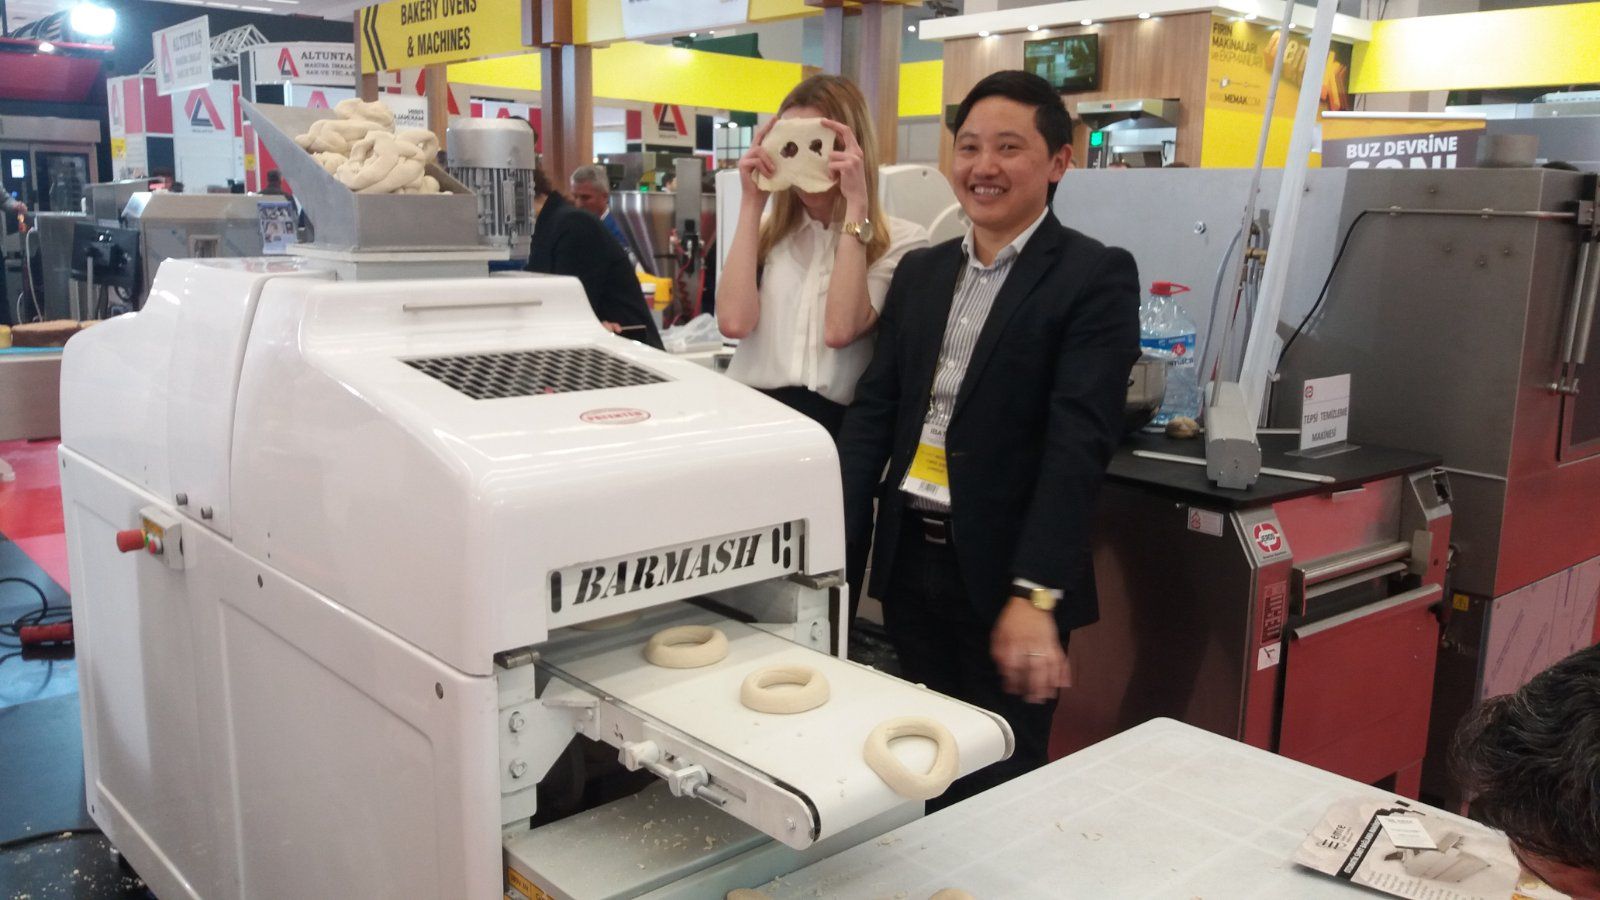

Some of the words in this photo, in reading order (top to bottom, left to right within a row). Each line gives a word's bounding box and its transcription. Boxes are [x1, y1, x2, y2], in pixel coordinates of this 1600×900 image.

[401, 0, 438, 26] BAKERY
[442, 0, 477, 17] OVENS
[1212, 22, 1233, 36] FIRIN
[407, 36, 414, 58] &
[417, 26, 471, 56] MACHINES
[301, 51, 354, 61] ALTUNTA
[1346, 143, 1381, 159] BUZ
[1383, 134, 1458, 156] DEVRİNE
[571, 533, 763, 605] BARMASH
